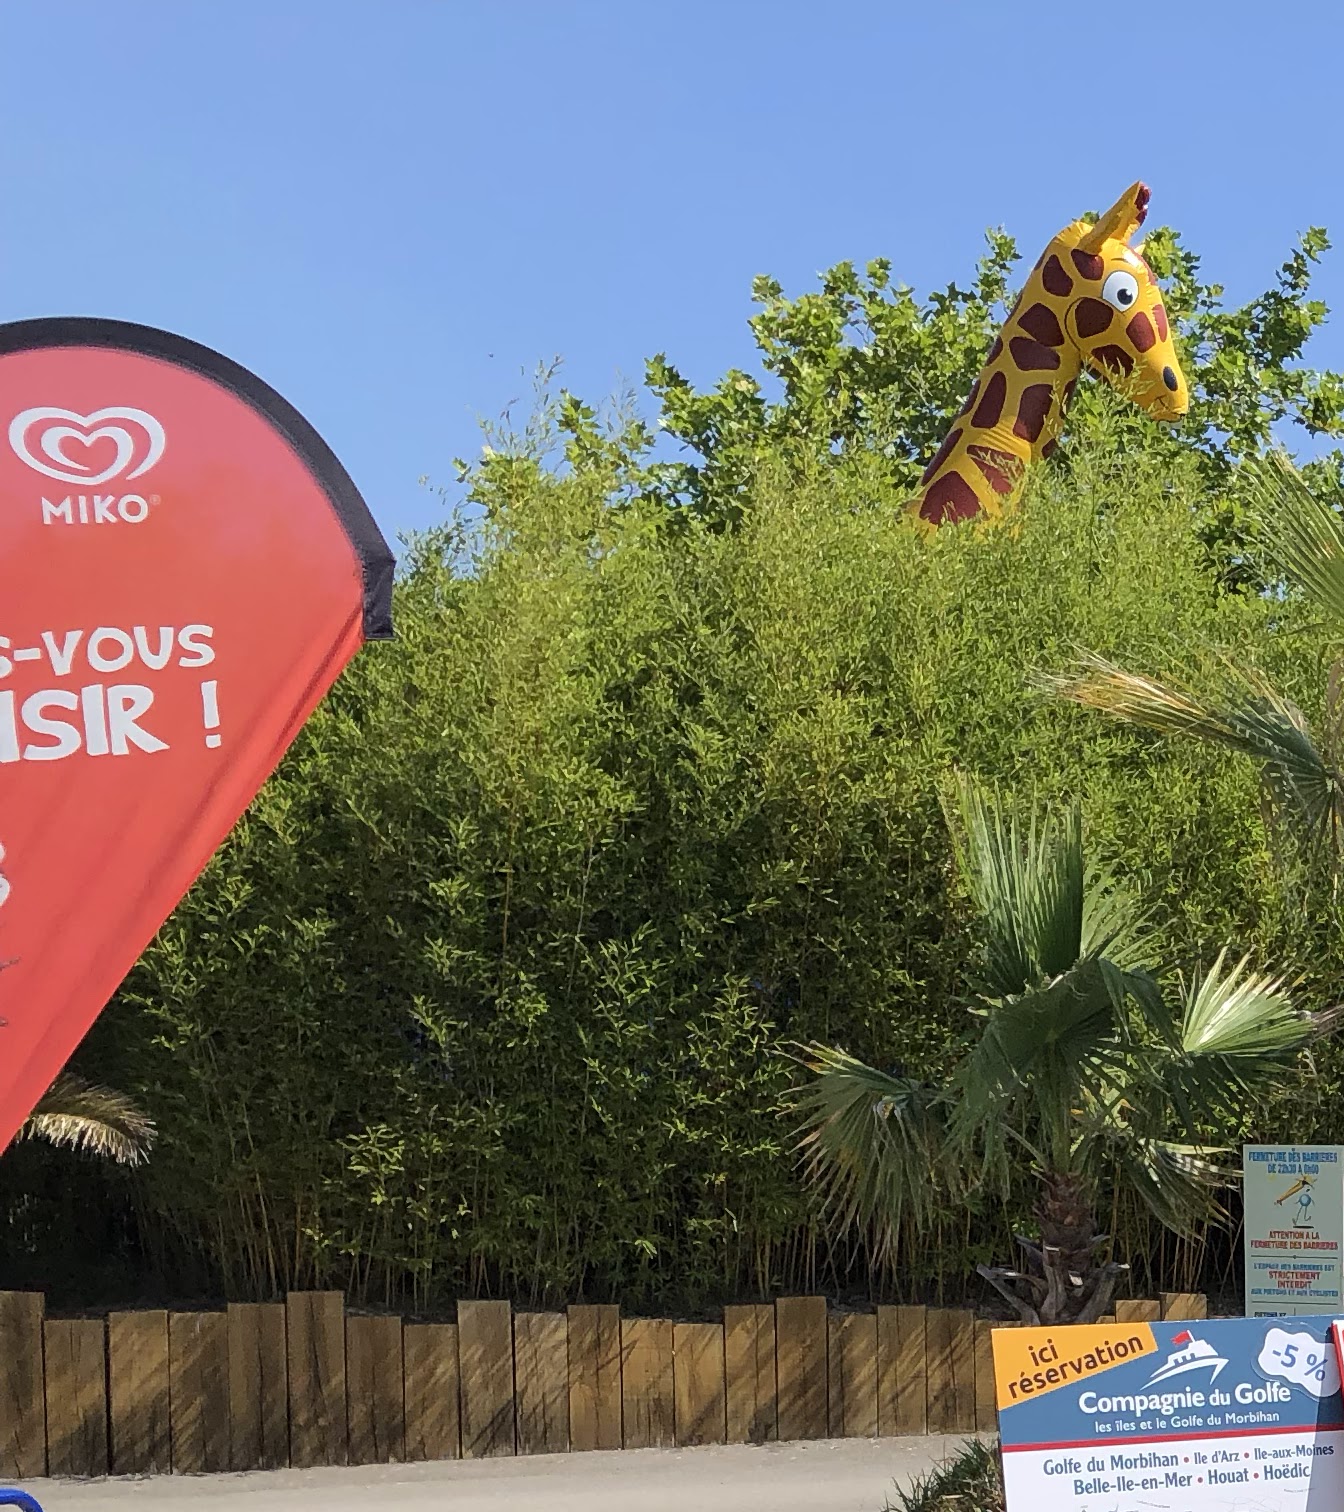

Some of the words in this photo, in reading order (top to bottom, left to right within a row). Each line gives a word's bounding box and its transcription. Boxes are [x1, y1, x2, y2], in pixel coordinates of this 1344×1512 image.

[42, 494, 150, 525] MIKO
[1269, 1230, 1304, 1240] ATTENTION
[1311, 1231, 1320, 1240] LA
[1289, 1241, 1302, 1250] DES
[1268, 1270, 1321, 1280] STRICTEMENT
[1277, 1280, 1312, 1289] INTERDIT
[1028, 1337, 1059, 1369] ici
[1007, 1334, 1145, 1400] réservation
[1303, 1352, 1327, 1383] %
[1078, 1385, 1206, 1418] Compagnie
[1208, 1388, 1232, 1407] du
[1233, 1382, 1292, 1405] Golfe
[1094, 1420, 1114, 1434] les
[1139, 1420, 1153, 1431] et
[1155, 1417, 1167, 1430] le
[1171, 1415, 1204, 1430] Golfe
[1206, 1414, 1222, 1427] du
[1224, 1411, 1280, 1425] Morbihan
[1042, 1456, 1083, 1477] Golfe
[1086, 1456, 1106, 1475] du
[1109, 1452, 1180, 1473] Morbihan
[1207, 1468, 1250, 1485] Houat
[1263, 1464, 1311, 1481] Hoëdic
